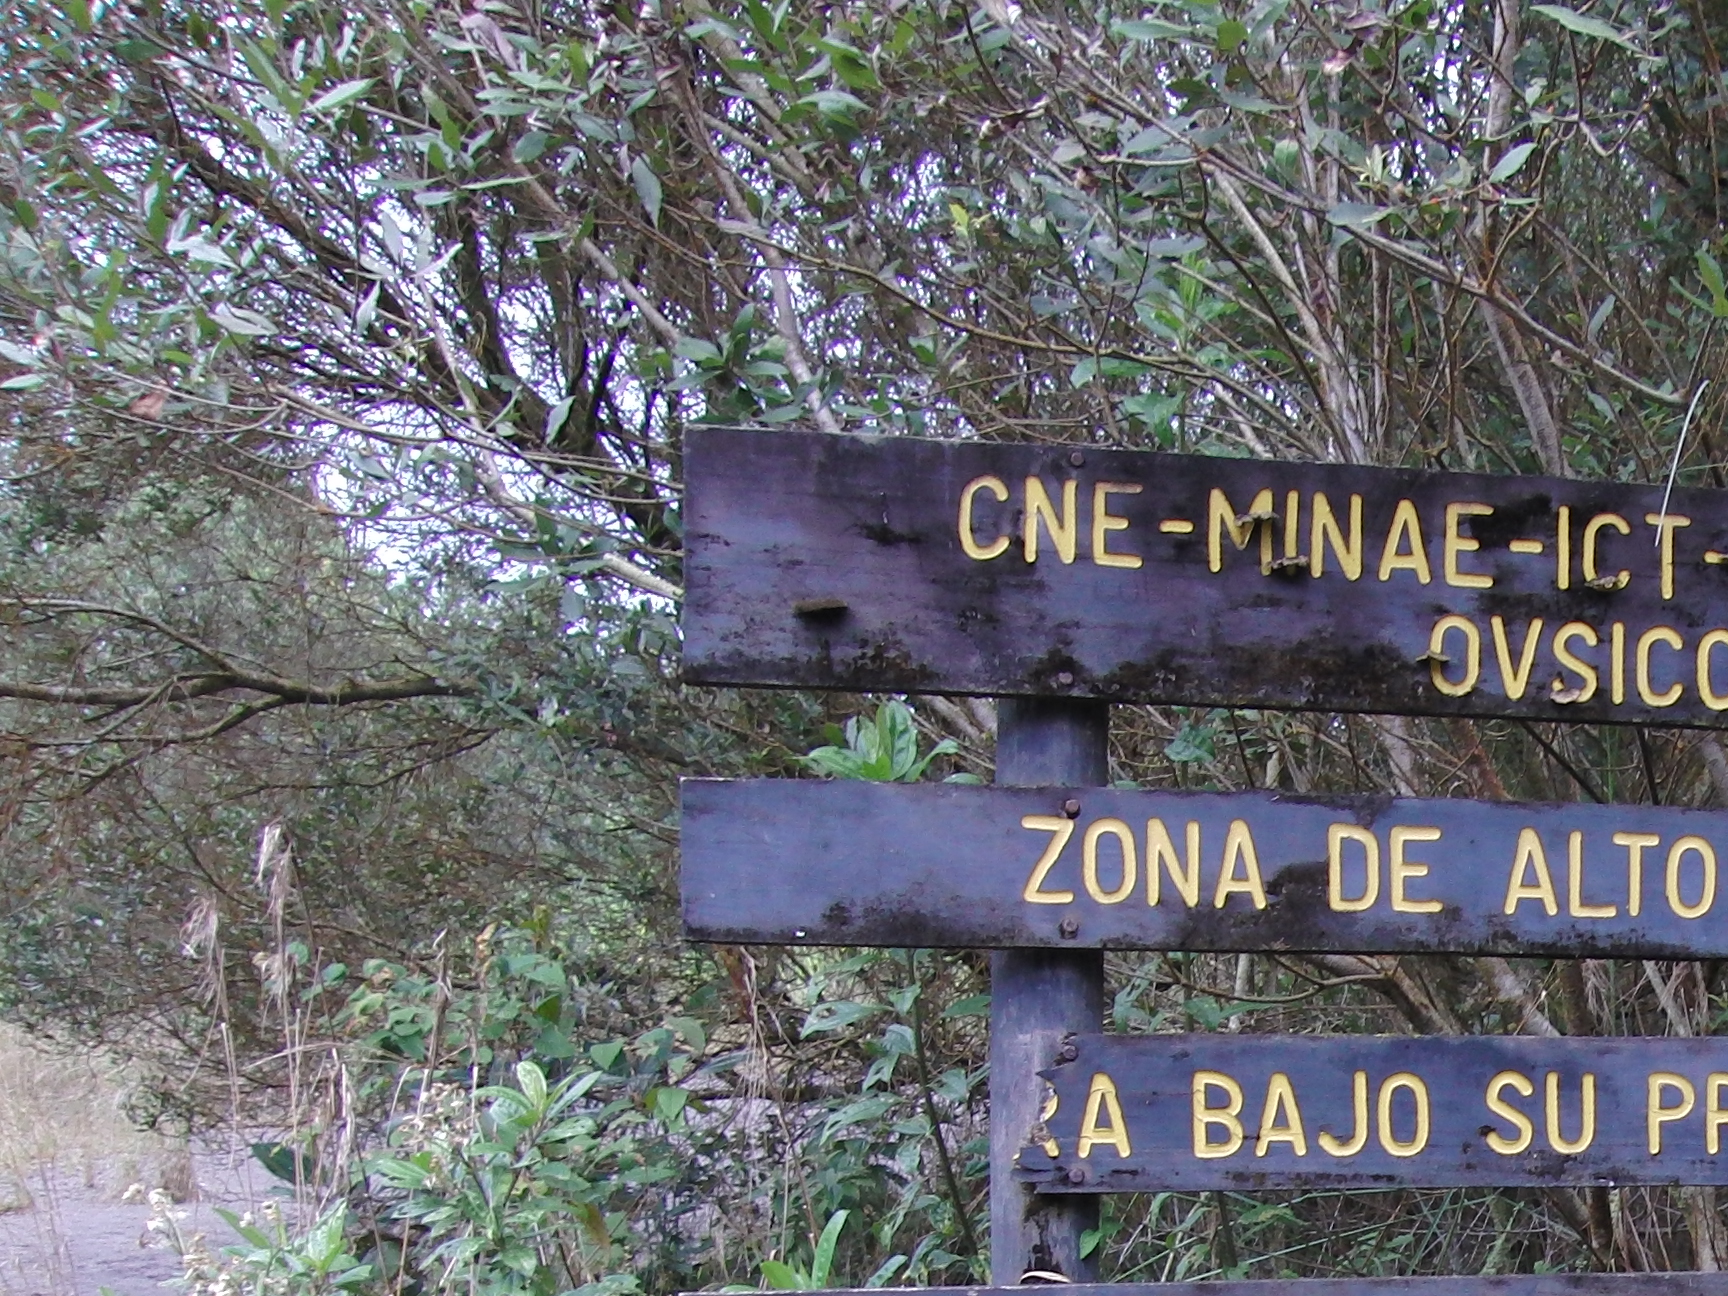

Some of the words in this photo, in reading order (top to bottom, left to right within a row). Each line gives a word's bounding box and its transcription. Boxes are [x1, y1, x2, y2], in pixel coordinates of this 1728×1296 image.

[1023, 815, 1268, 911] ZONA
[1327, 823, 1444, 913] DE
[1504, 827, 1717, 917] ALTO
[1192, 1069, 1431, 1156] BAJO
[1485, 1069, 1596, 1153] SU
